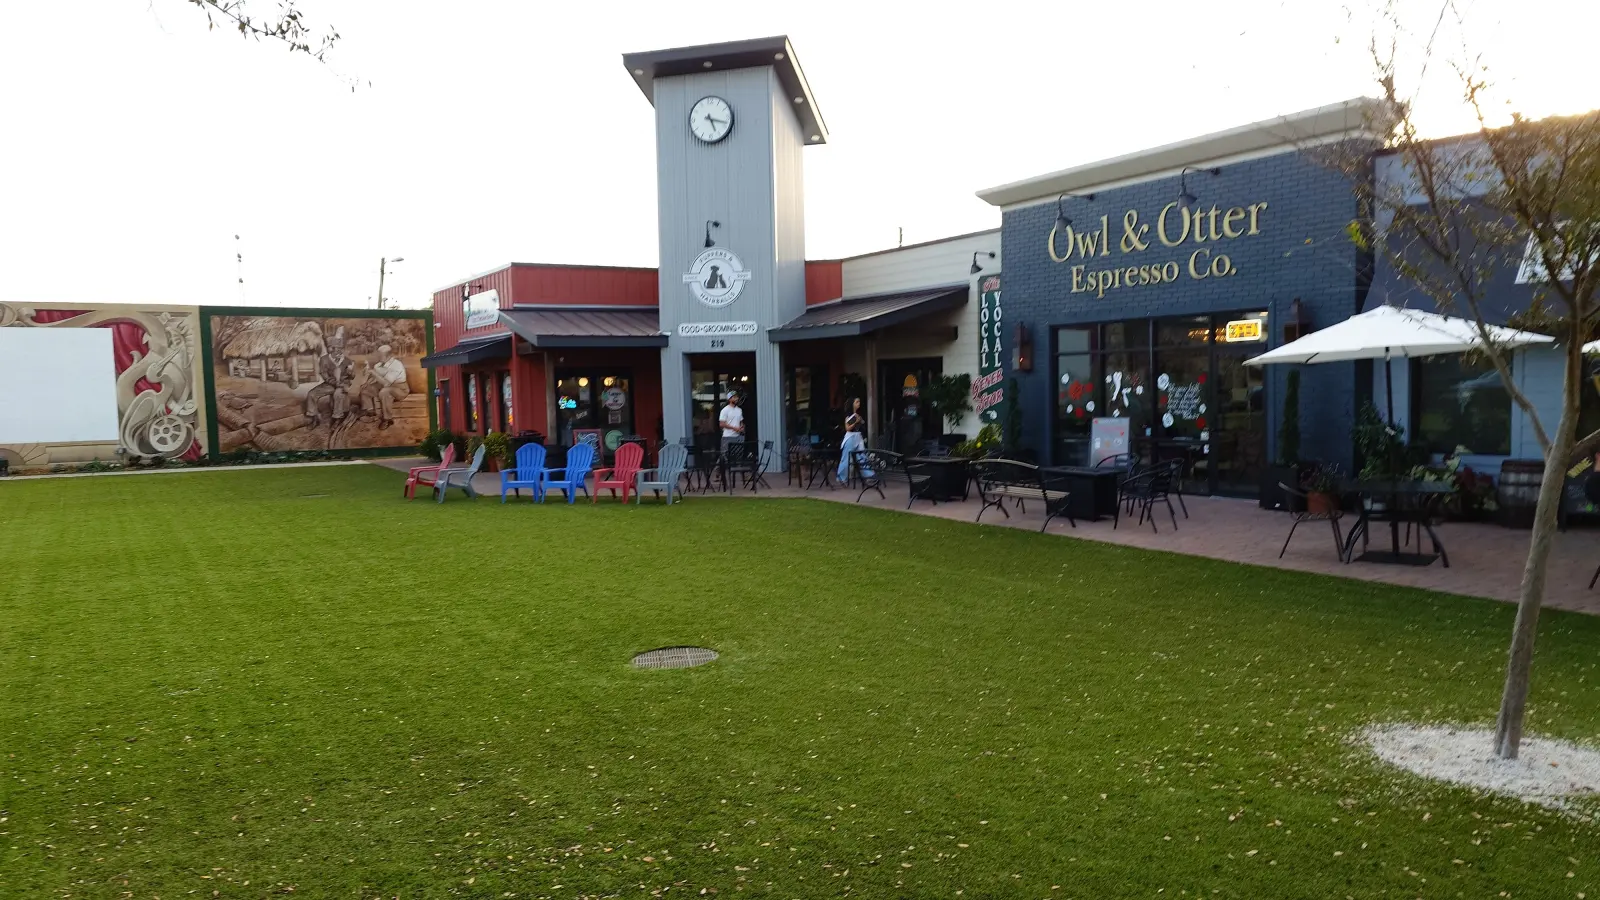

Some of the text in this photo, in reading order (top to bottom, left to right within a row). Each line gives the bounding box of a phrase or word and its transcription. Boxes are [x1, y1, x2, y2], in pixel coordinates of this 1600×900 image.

[1048, 201, 1268, 263] Owl & Otter
[1070, 247, 1238, 299] Espresso Co.
[680, 325, 700, 335] FOOD
[710, 339, 725, 348] 219
[980, 291, 990, 369] LOCAL
[993, 290, 1003, 368] YOCAL
